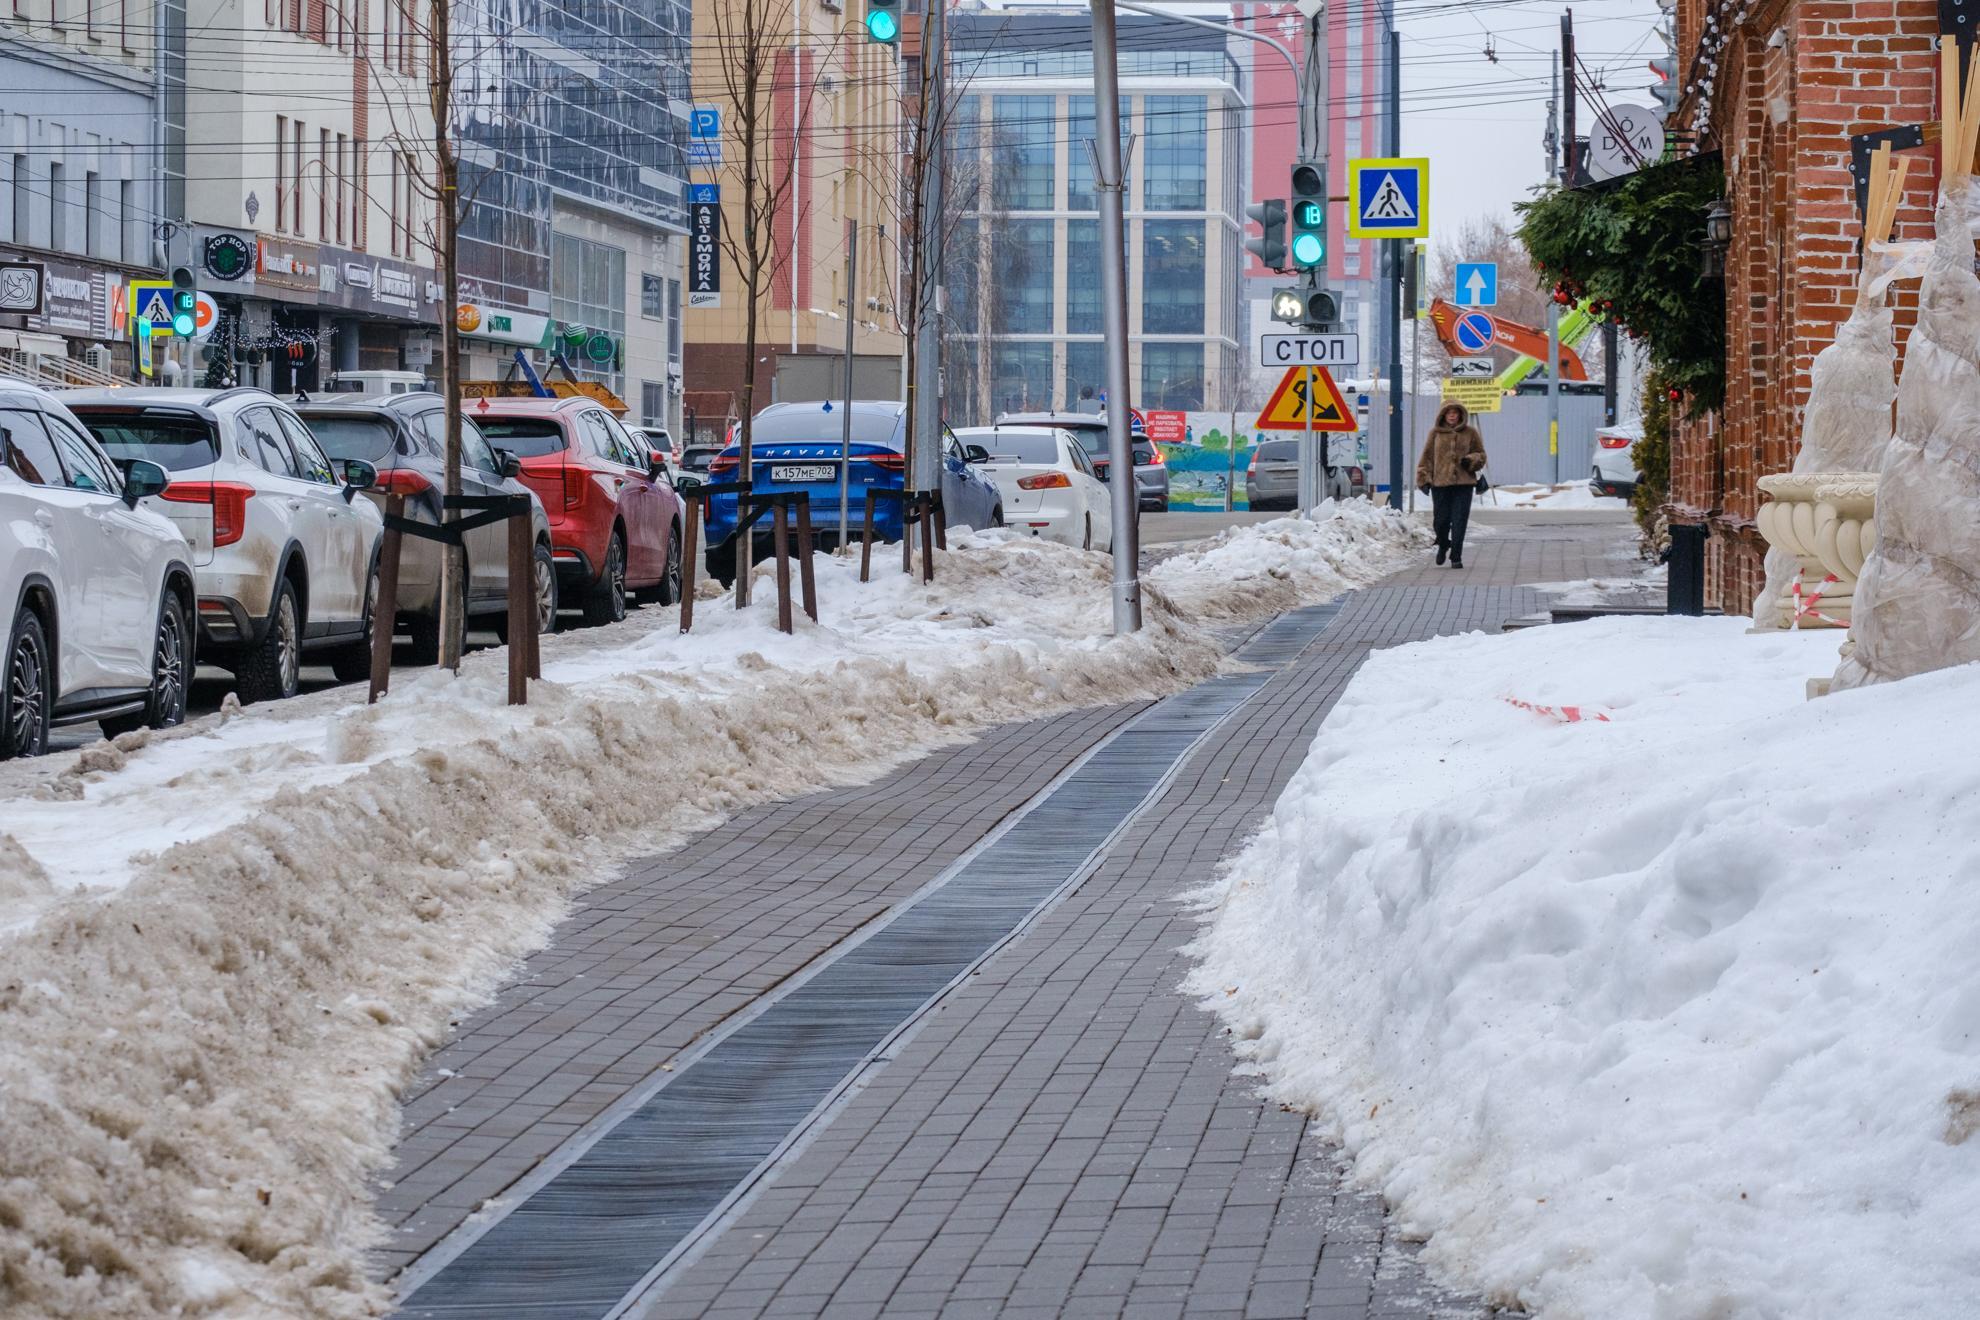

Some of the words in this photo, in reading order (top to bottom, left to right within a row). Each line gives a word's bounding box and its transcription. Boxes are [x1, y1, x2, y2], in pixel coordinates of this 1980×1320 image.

[1305, 206, 1321, 224] 18
[209, 236, 226, 250] TOP
[228, 237, 246, 253] HOP
[696, 206, 713, 290] АВТОМОЙКА
[457, 311, 471, 320] 24
[1496, 330, 1515, 342] ACHI
[1276, 340, 1344, 360] СТОП
